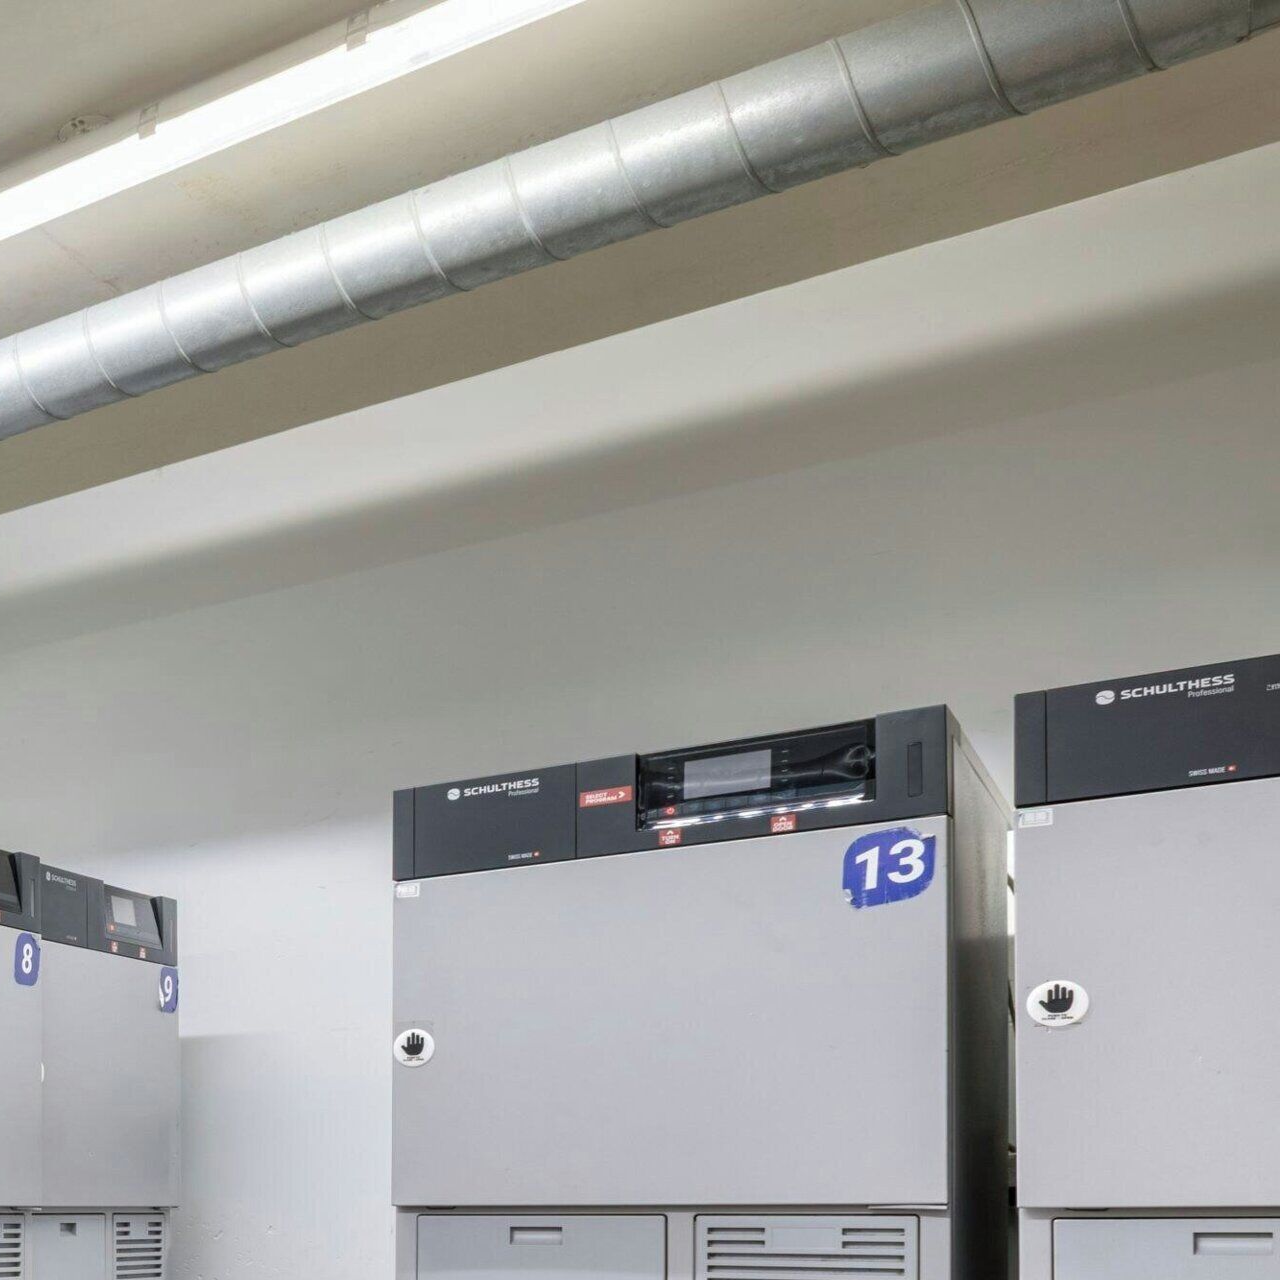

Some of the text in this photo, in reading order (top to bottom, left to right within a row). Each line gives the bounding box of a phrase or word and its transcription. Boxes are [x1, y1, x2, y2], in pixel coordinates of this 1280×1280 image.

[1120, 674, 1235, 699] SCHULTHESS
[1188, 685, 1234, 698] Professional
[1189, 766, 1225, 777] SWISS MADE
[464, 778, 539, 797] SCHULTHESS
[508, 788, 539, 797] Professional
[855, 839, 925, 890] 13
[21, 944, 33, 974] 8
[164, 976, 172, 1001] 9
